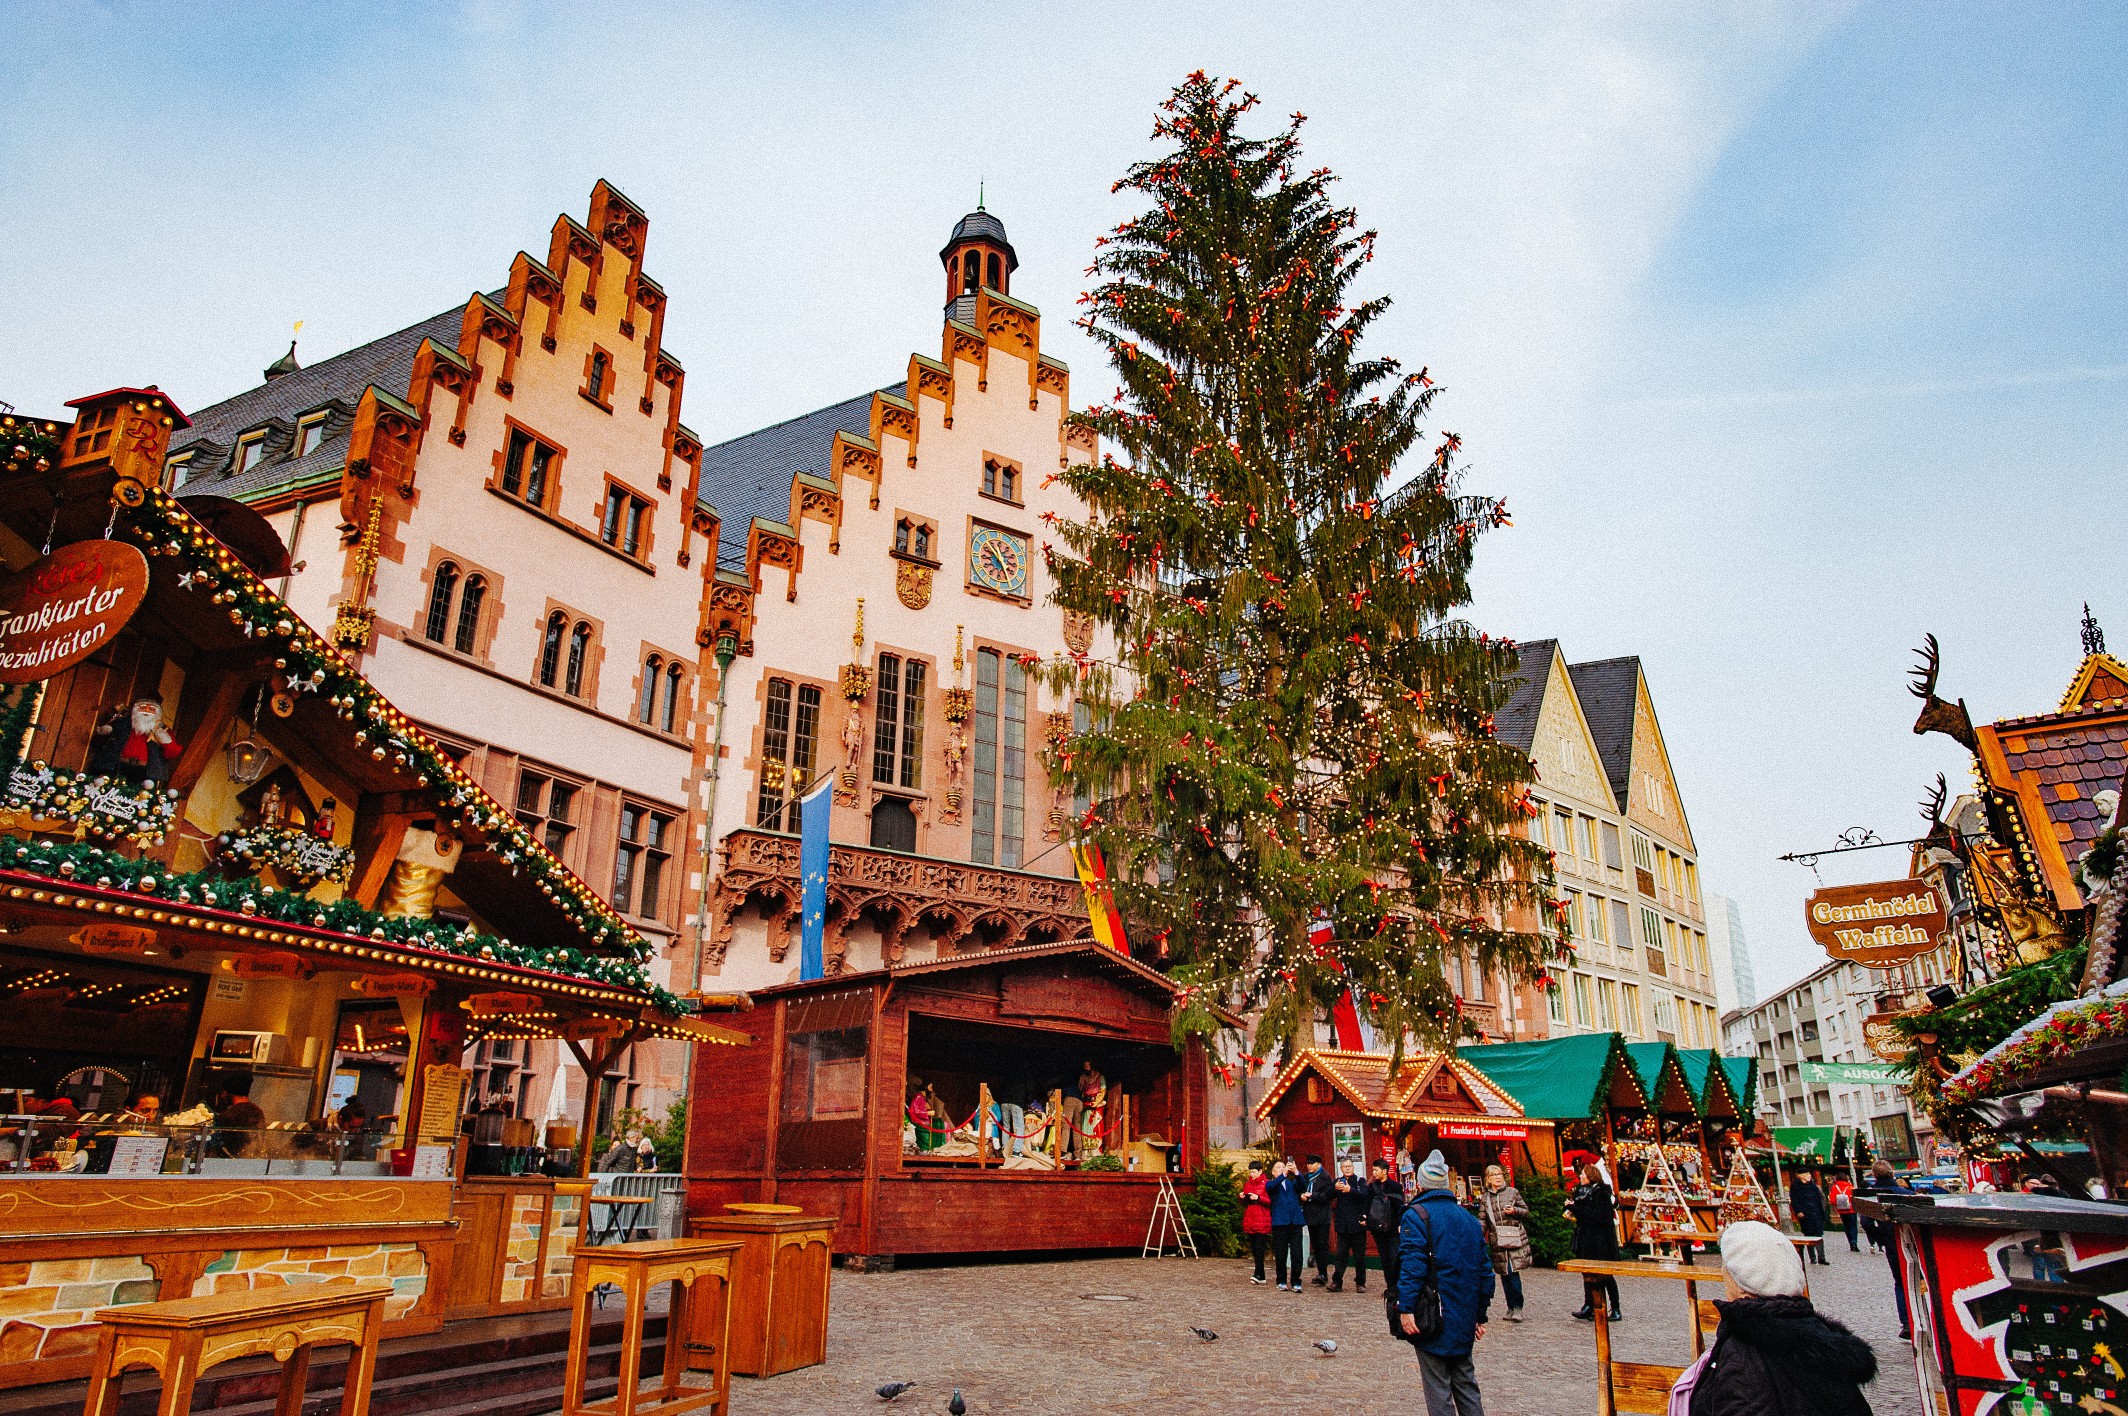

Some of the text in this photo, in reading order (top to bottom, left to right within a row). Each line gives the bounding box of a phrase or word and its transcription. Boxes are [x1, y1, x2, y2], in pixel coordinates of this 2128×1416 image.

[0, 585, 125, 639] rankfurter
[0, 622, 106, 668] pezialitäten
[1812, 891, 1938, 925] Germknödel
[1834, 923, 1930, 950] Waffeln
[1450, 1126, 1475, 1136] Frankfurt
[1475, 1126, 1481, 1136] &
